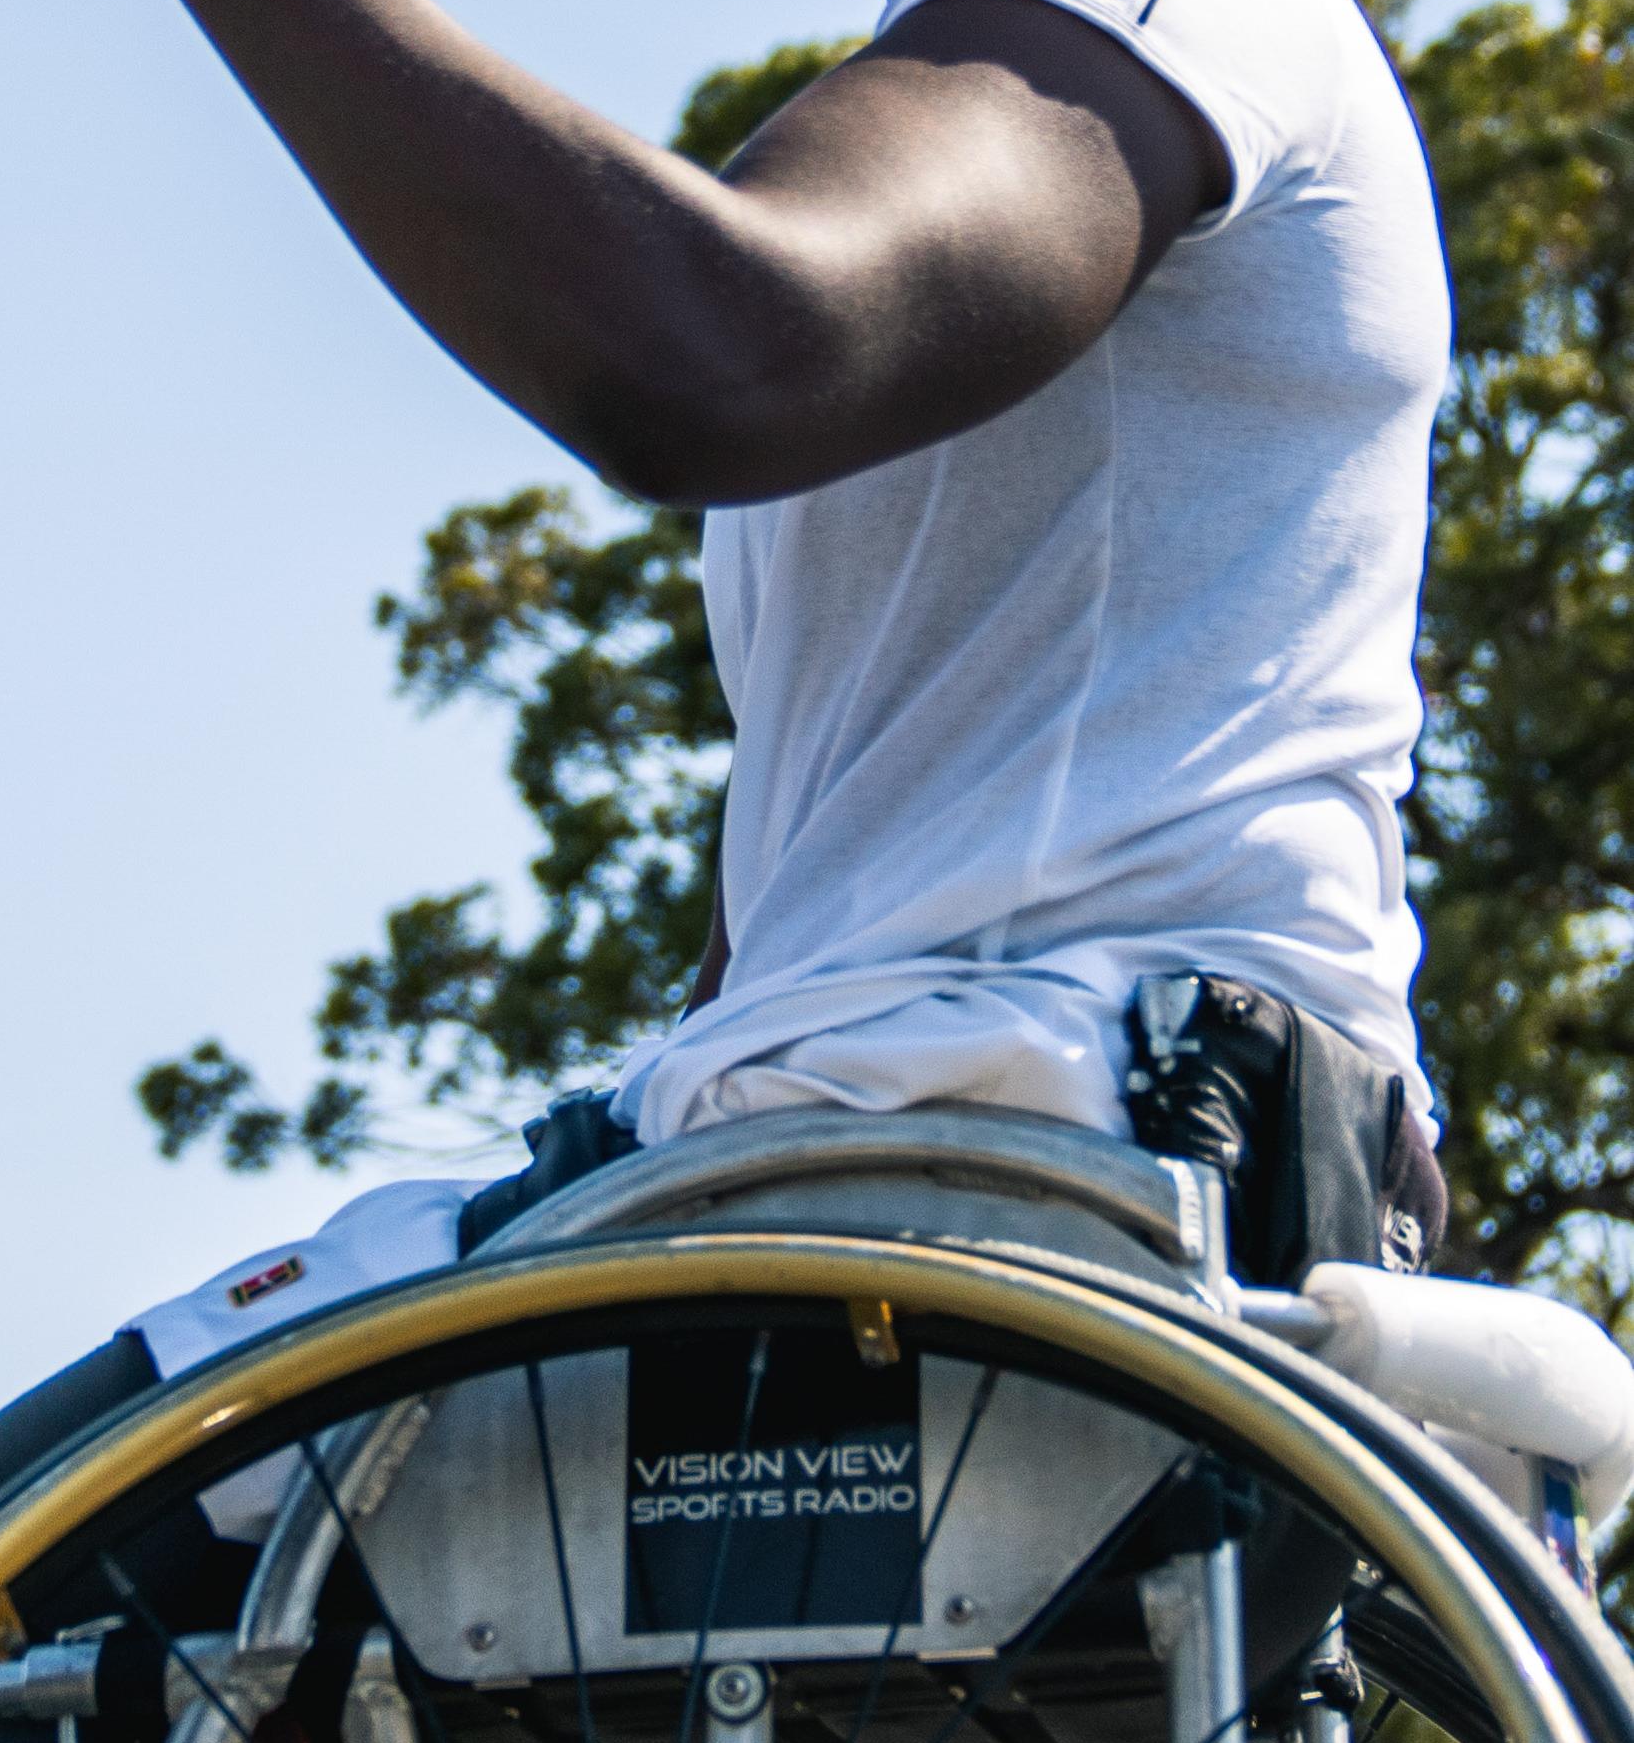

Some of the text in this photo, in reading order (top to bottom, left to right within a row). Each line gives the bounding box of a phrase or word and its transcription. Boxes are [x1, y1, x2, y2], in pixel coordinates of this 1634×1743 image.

[634, 1443, 913, 1486] VISION VIEW
[631, 1485, 915, 1523] SPORTS RADIO
